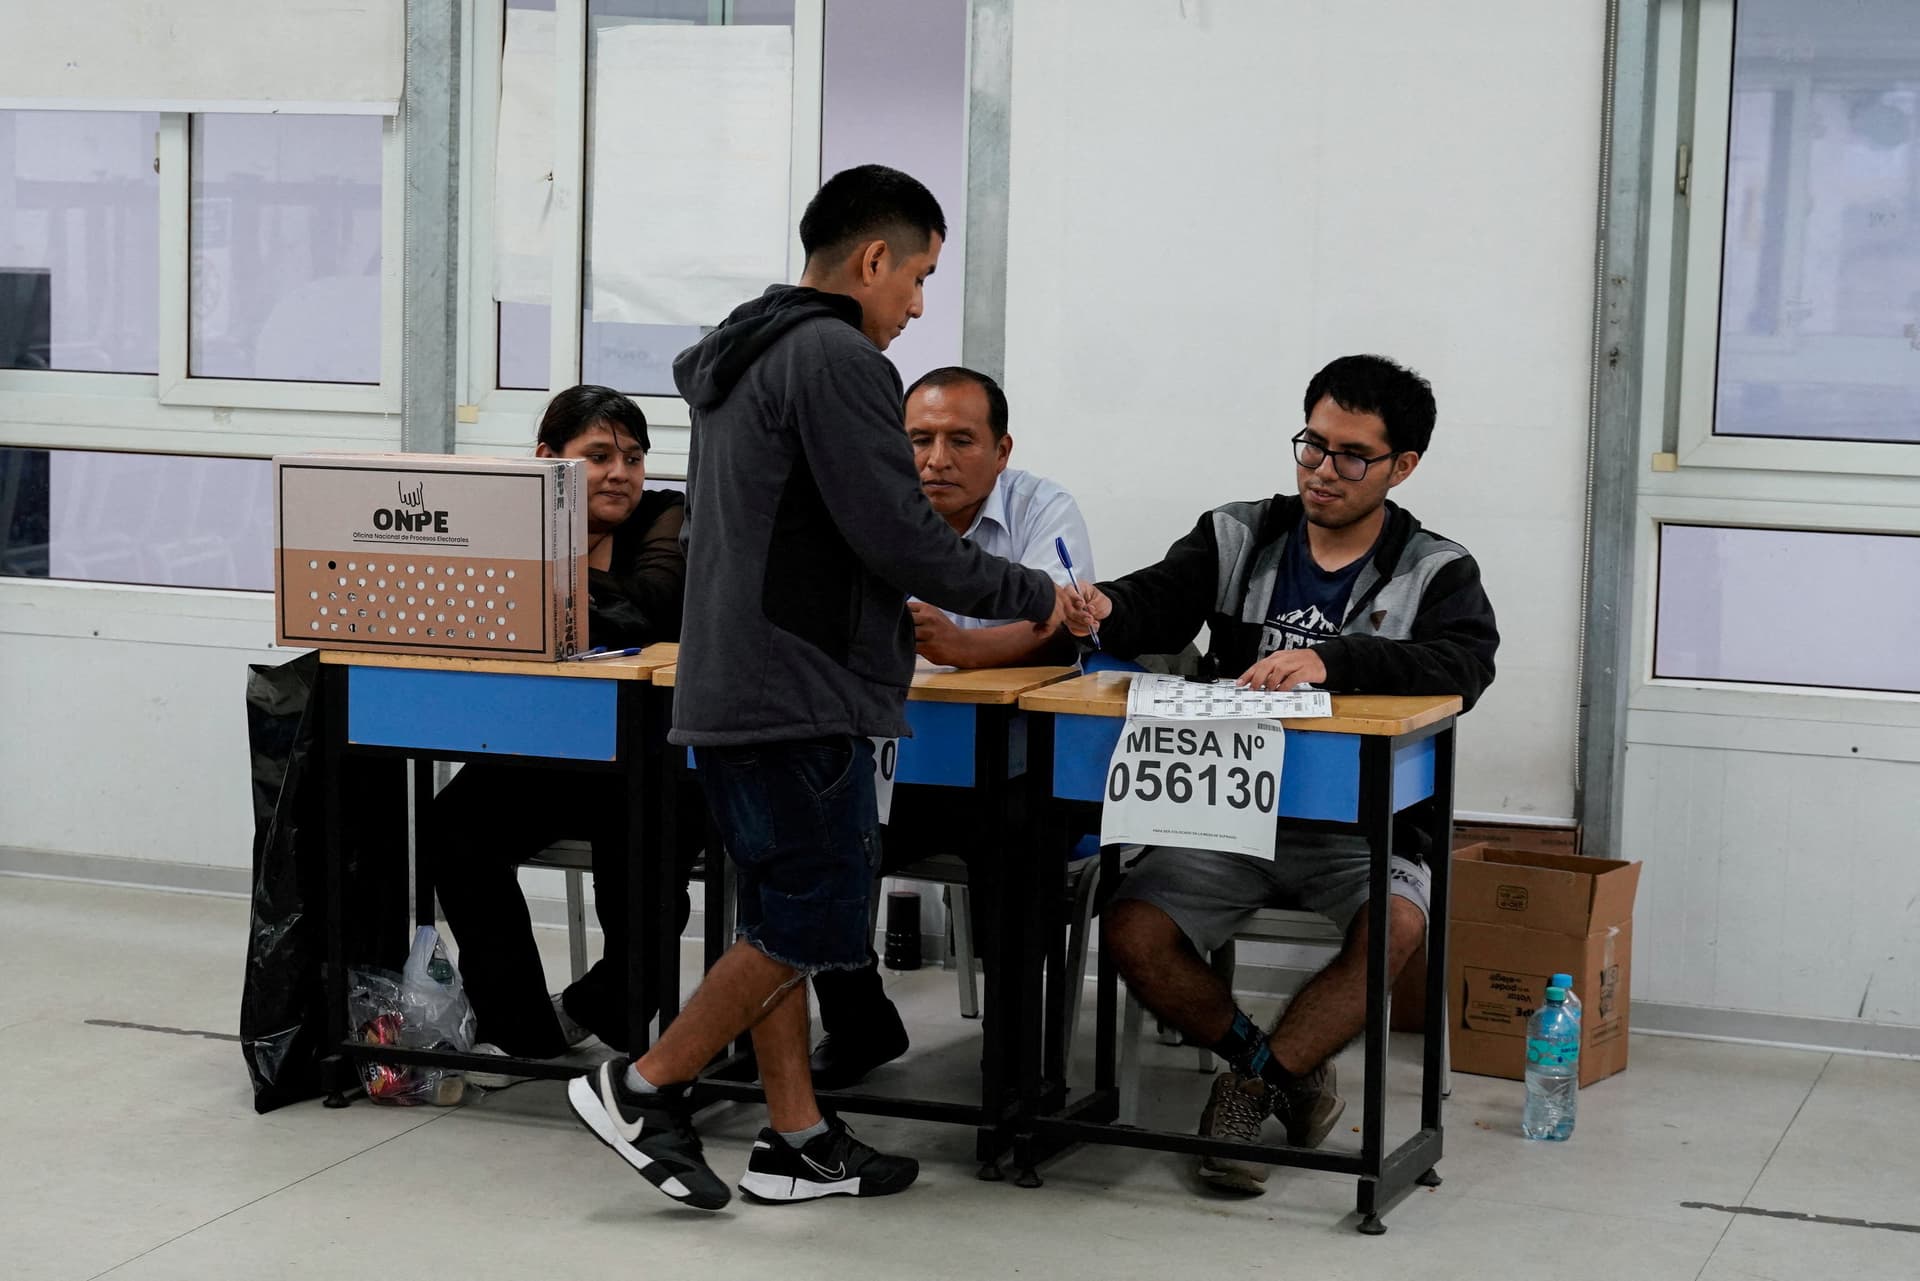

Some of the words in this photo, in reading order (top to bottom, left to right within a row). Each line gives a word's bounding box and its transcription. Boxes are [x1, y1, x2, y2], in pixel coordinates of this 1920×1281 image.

[373, 508, 449, 534] ONPE
[352, 531, 374, 540] Oficina
[374, 533, 401, 541] Nacional
[410, 534, 437, 542] Procesos
[437, 535, 470, 544] Electorales
[1126, 726, 1223, 758] MESA
[1108, 760, 1275, 814] 056130
